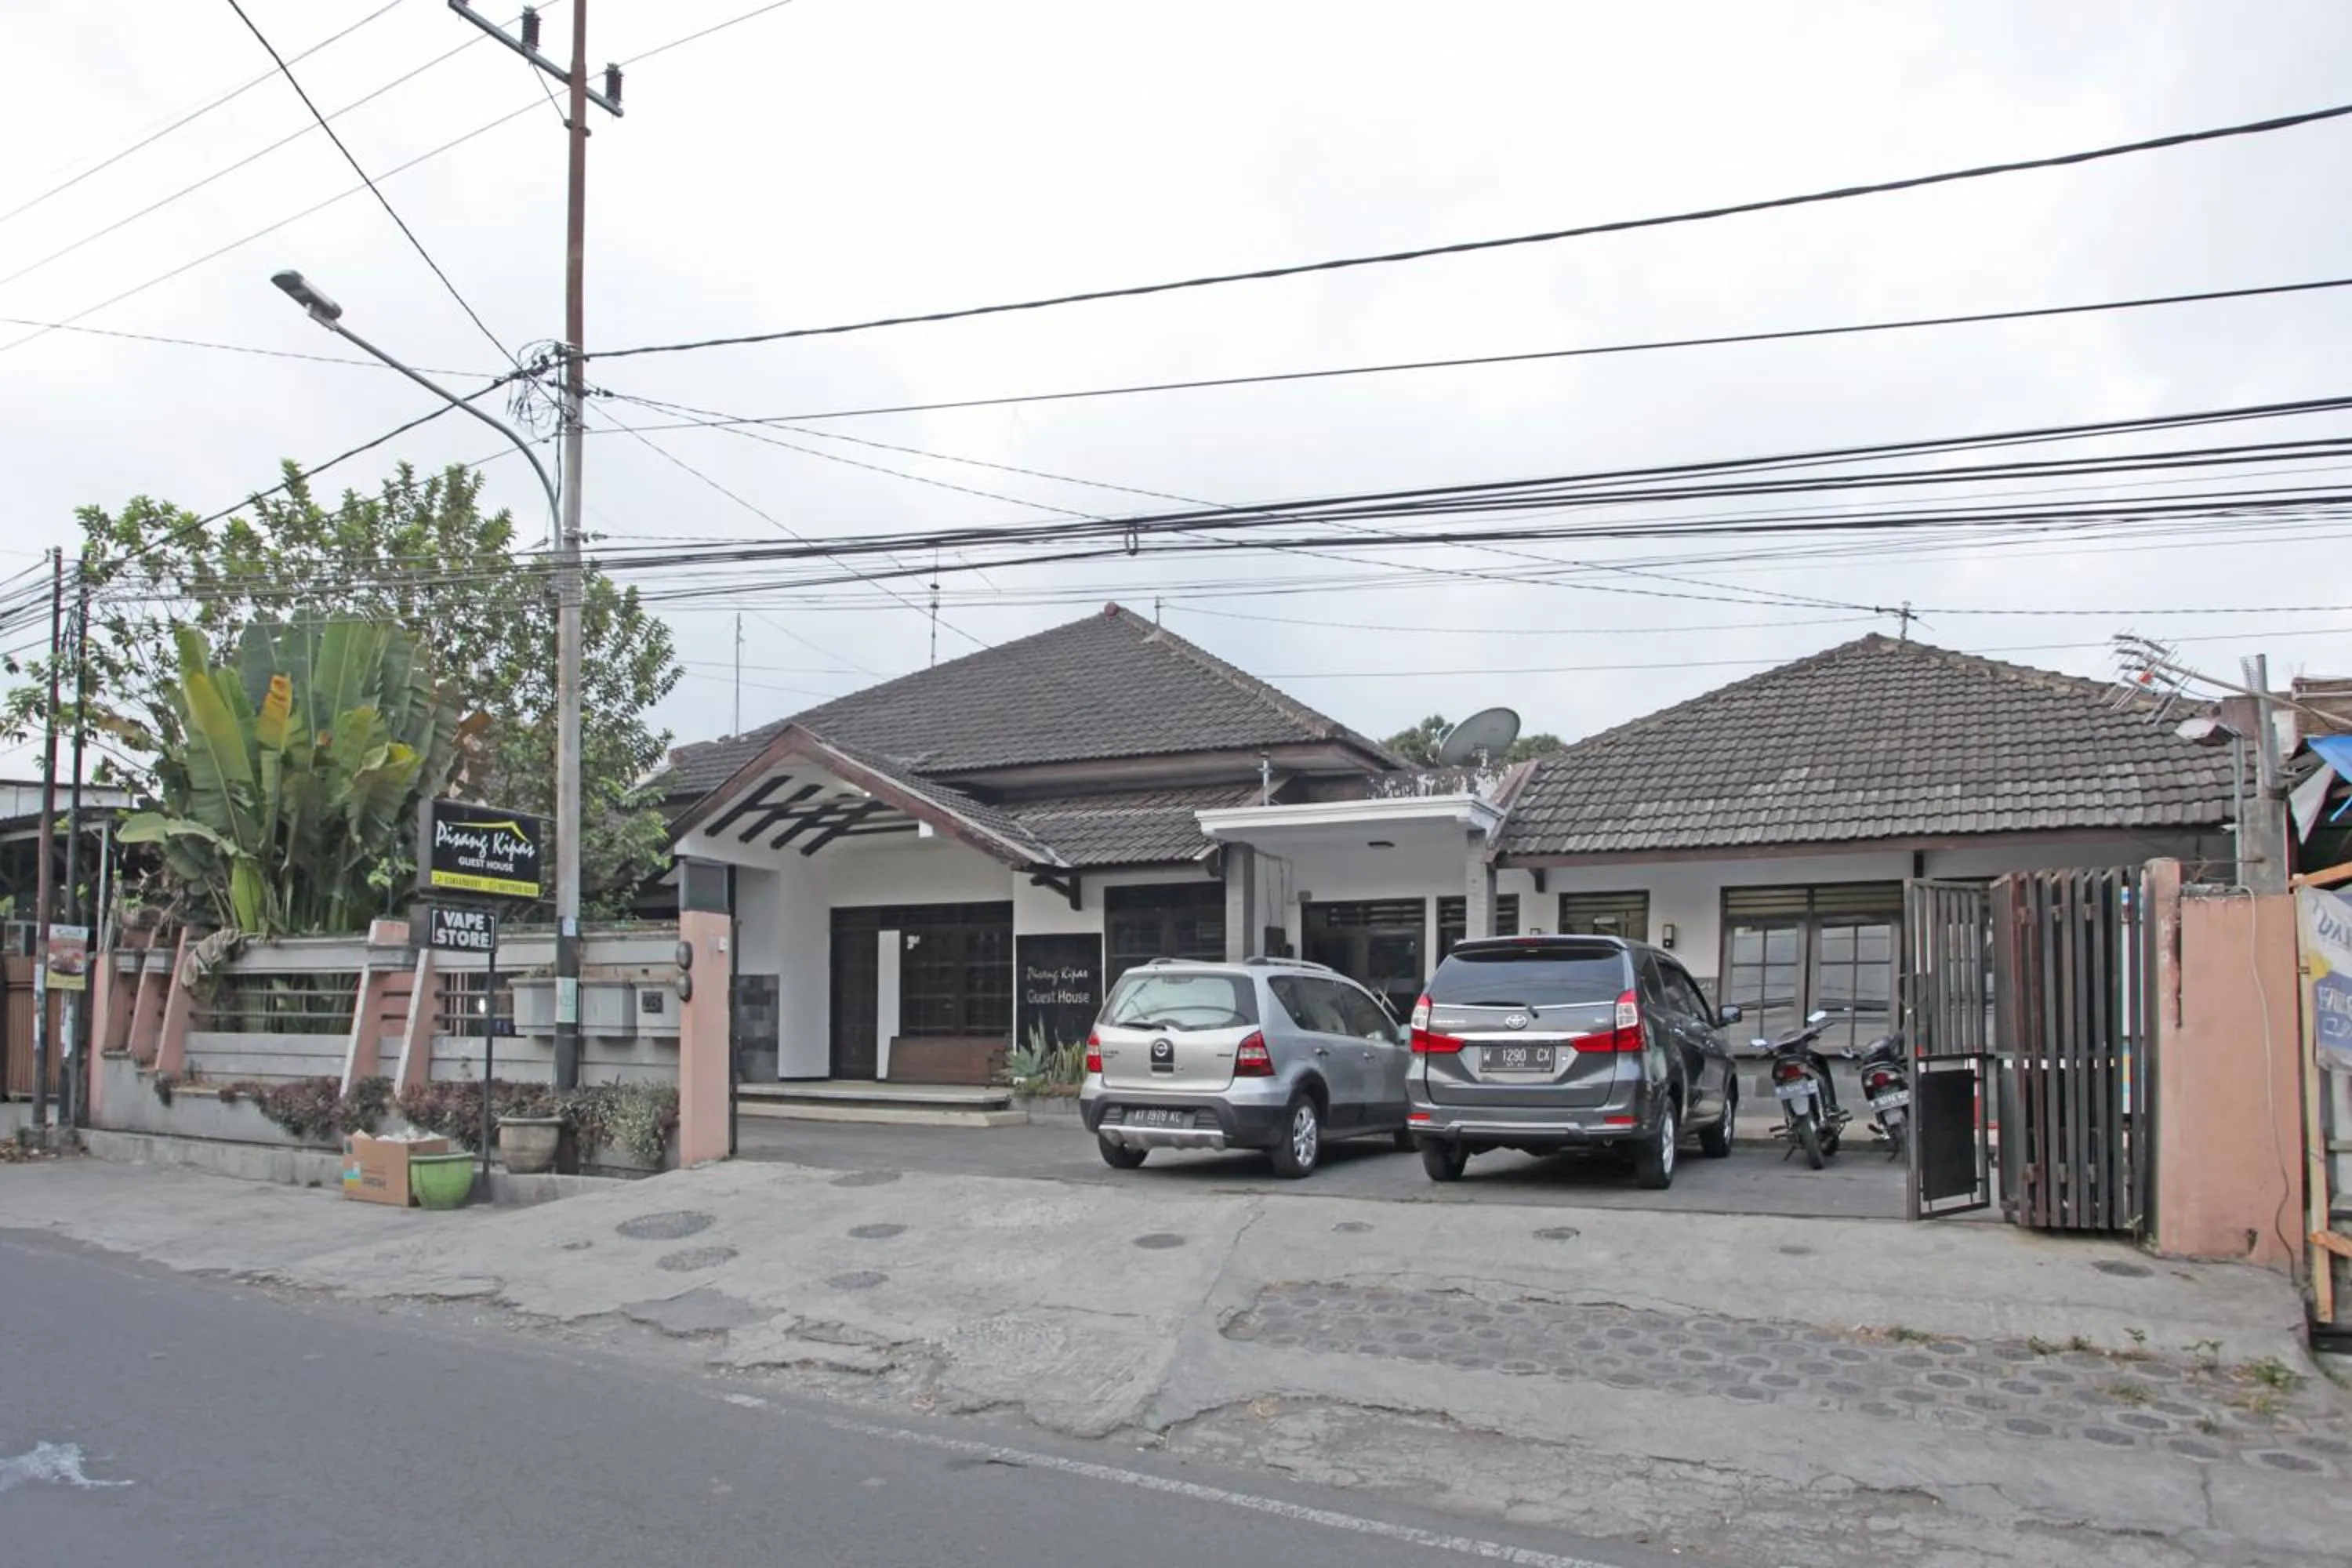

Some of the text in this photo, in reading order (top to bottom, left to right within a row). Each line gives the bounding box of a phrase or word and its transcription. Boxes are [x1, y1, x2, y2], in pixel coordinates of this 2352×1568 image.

[436, 819, 535, 862] Pisang Kipas
[458, 856, 514, 873] GUEST HOUSE
[442, 910, 485, 931] VAPE
[436, 928, 490, 948] STORE
[1537, 1047, 1550, 1062] CX
